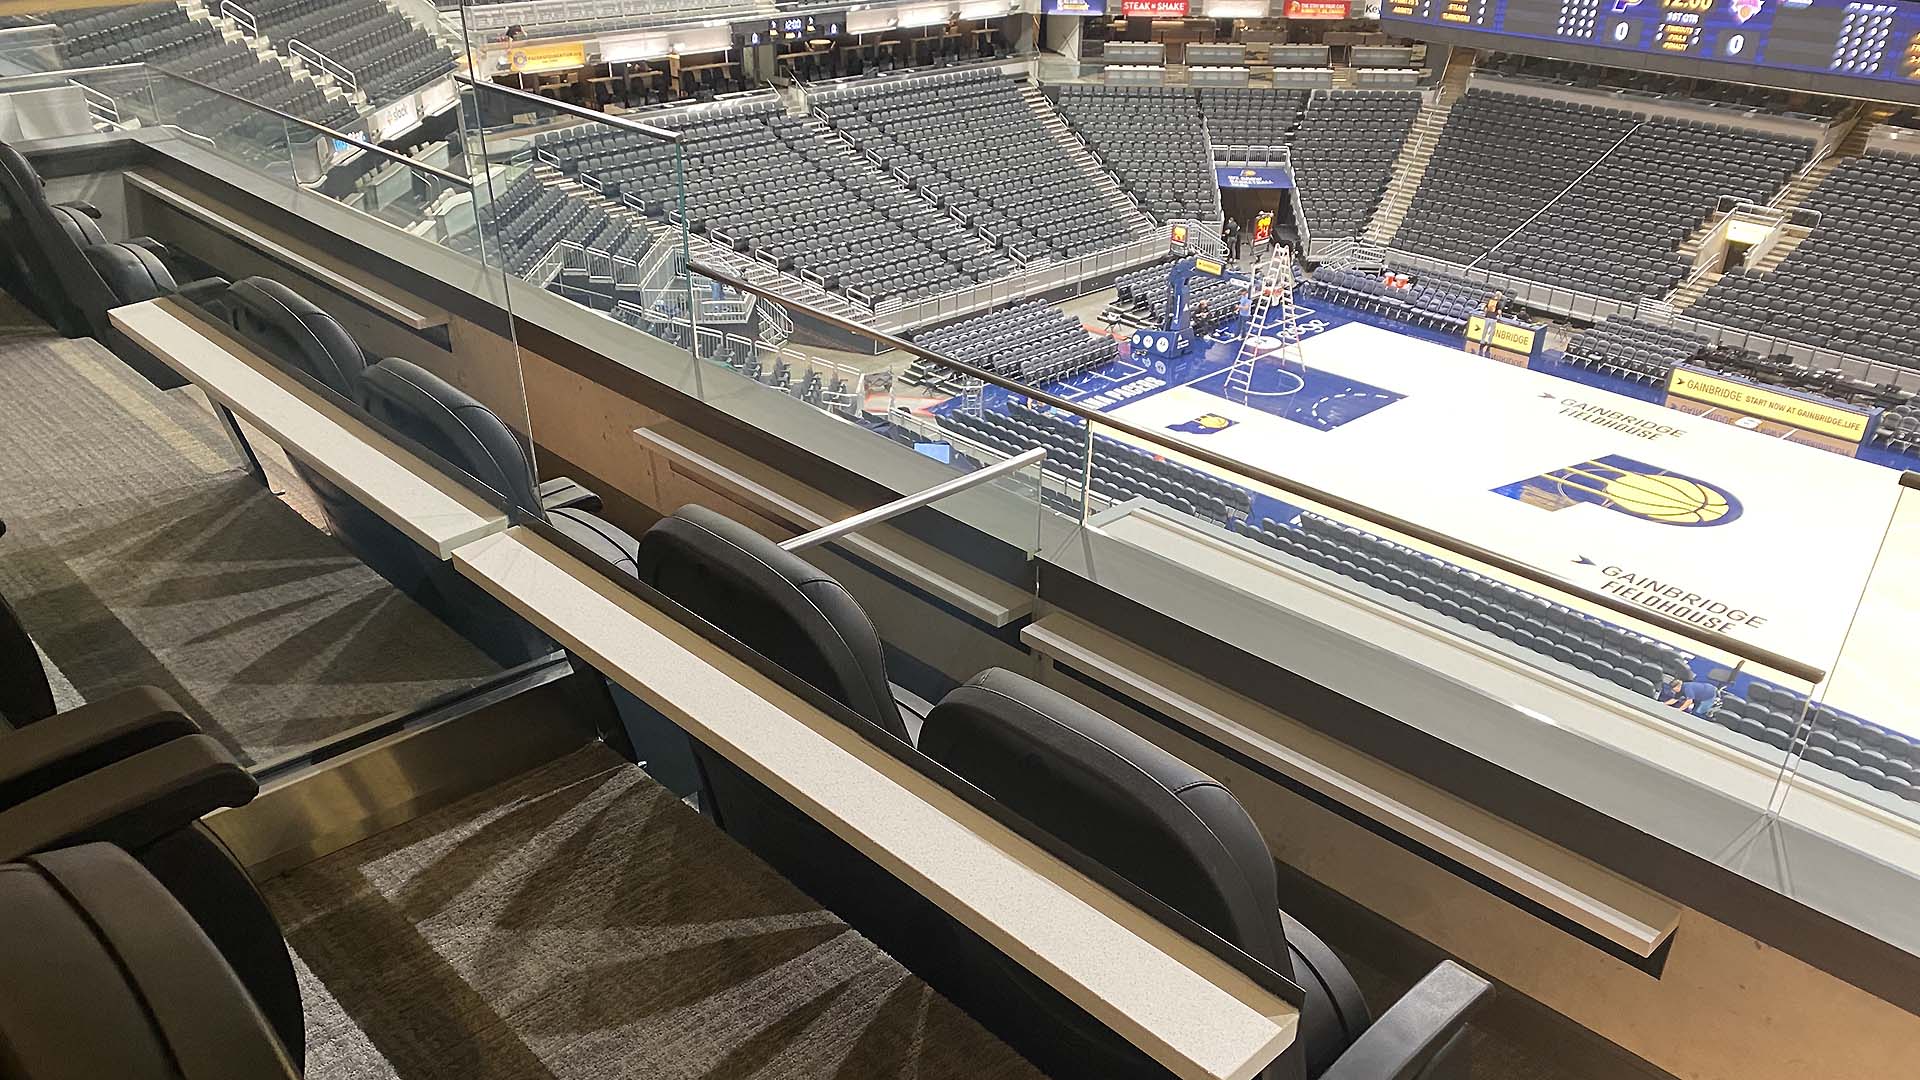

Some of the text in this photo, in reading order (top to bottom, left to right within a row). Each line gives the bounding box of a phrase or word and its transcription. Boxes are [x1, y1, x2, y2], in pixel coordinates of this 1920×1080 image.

[1123, 2, 1150, 10] STEAK
[1157, 2, 1185, 11] SHAKE
[785, 19, 802, 31] 12:00
[1615, 22, 1629, 41] 0
[1728, 34, 1744, 54] 0
[392, 102, 409, 120] slack
[1494, 329, 1530, 346] NBRIDGE
[1104, 377, 1167, 401] PACERS
[1687, 379, 1861, 431] GAINBRIDGE START NOW AT GAINBRIDGE.LIFE
[1558, 407, 1663, 441] FIELDHOUSE
[1560, 398, 1688, 438] GAINBRIDGE
[1600, 580, 1737, 634] FIELDHOUSE
[1601, 565, 1768, 629] GAINBRIDGE
